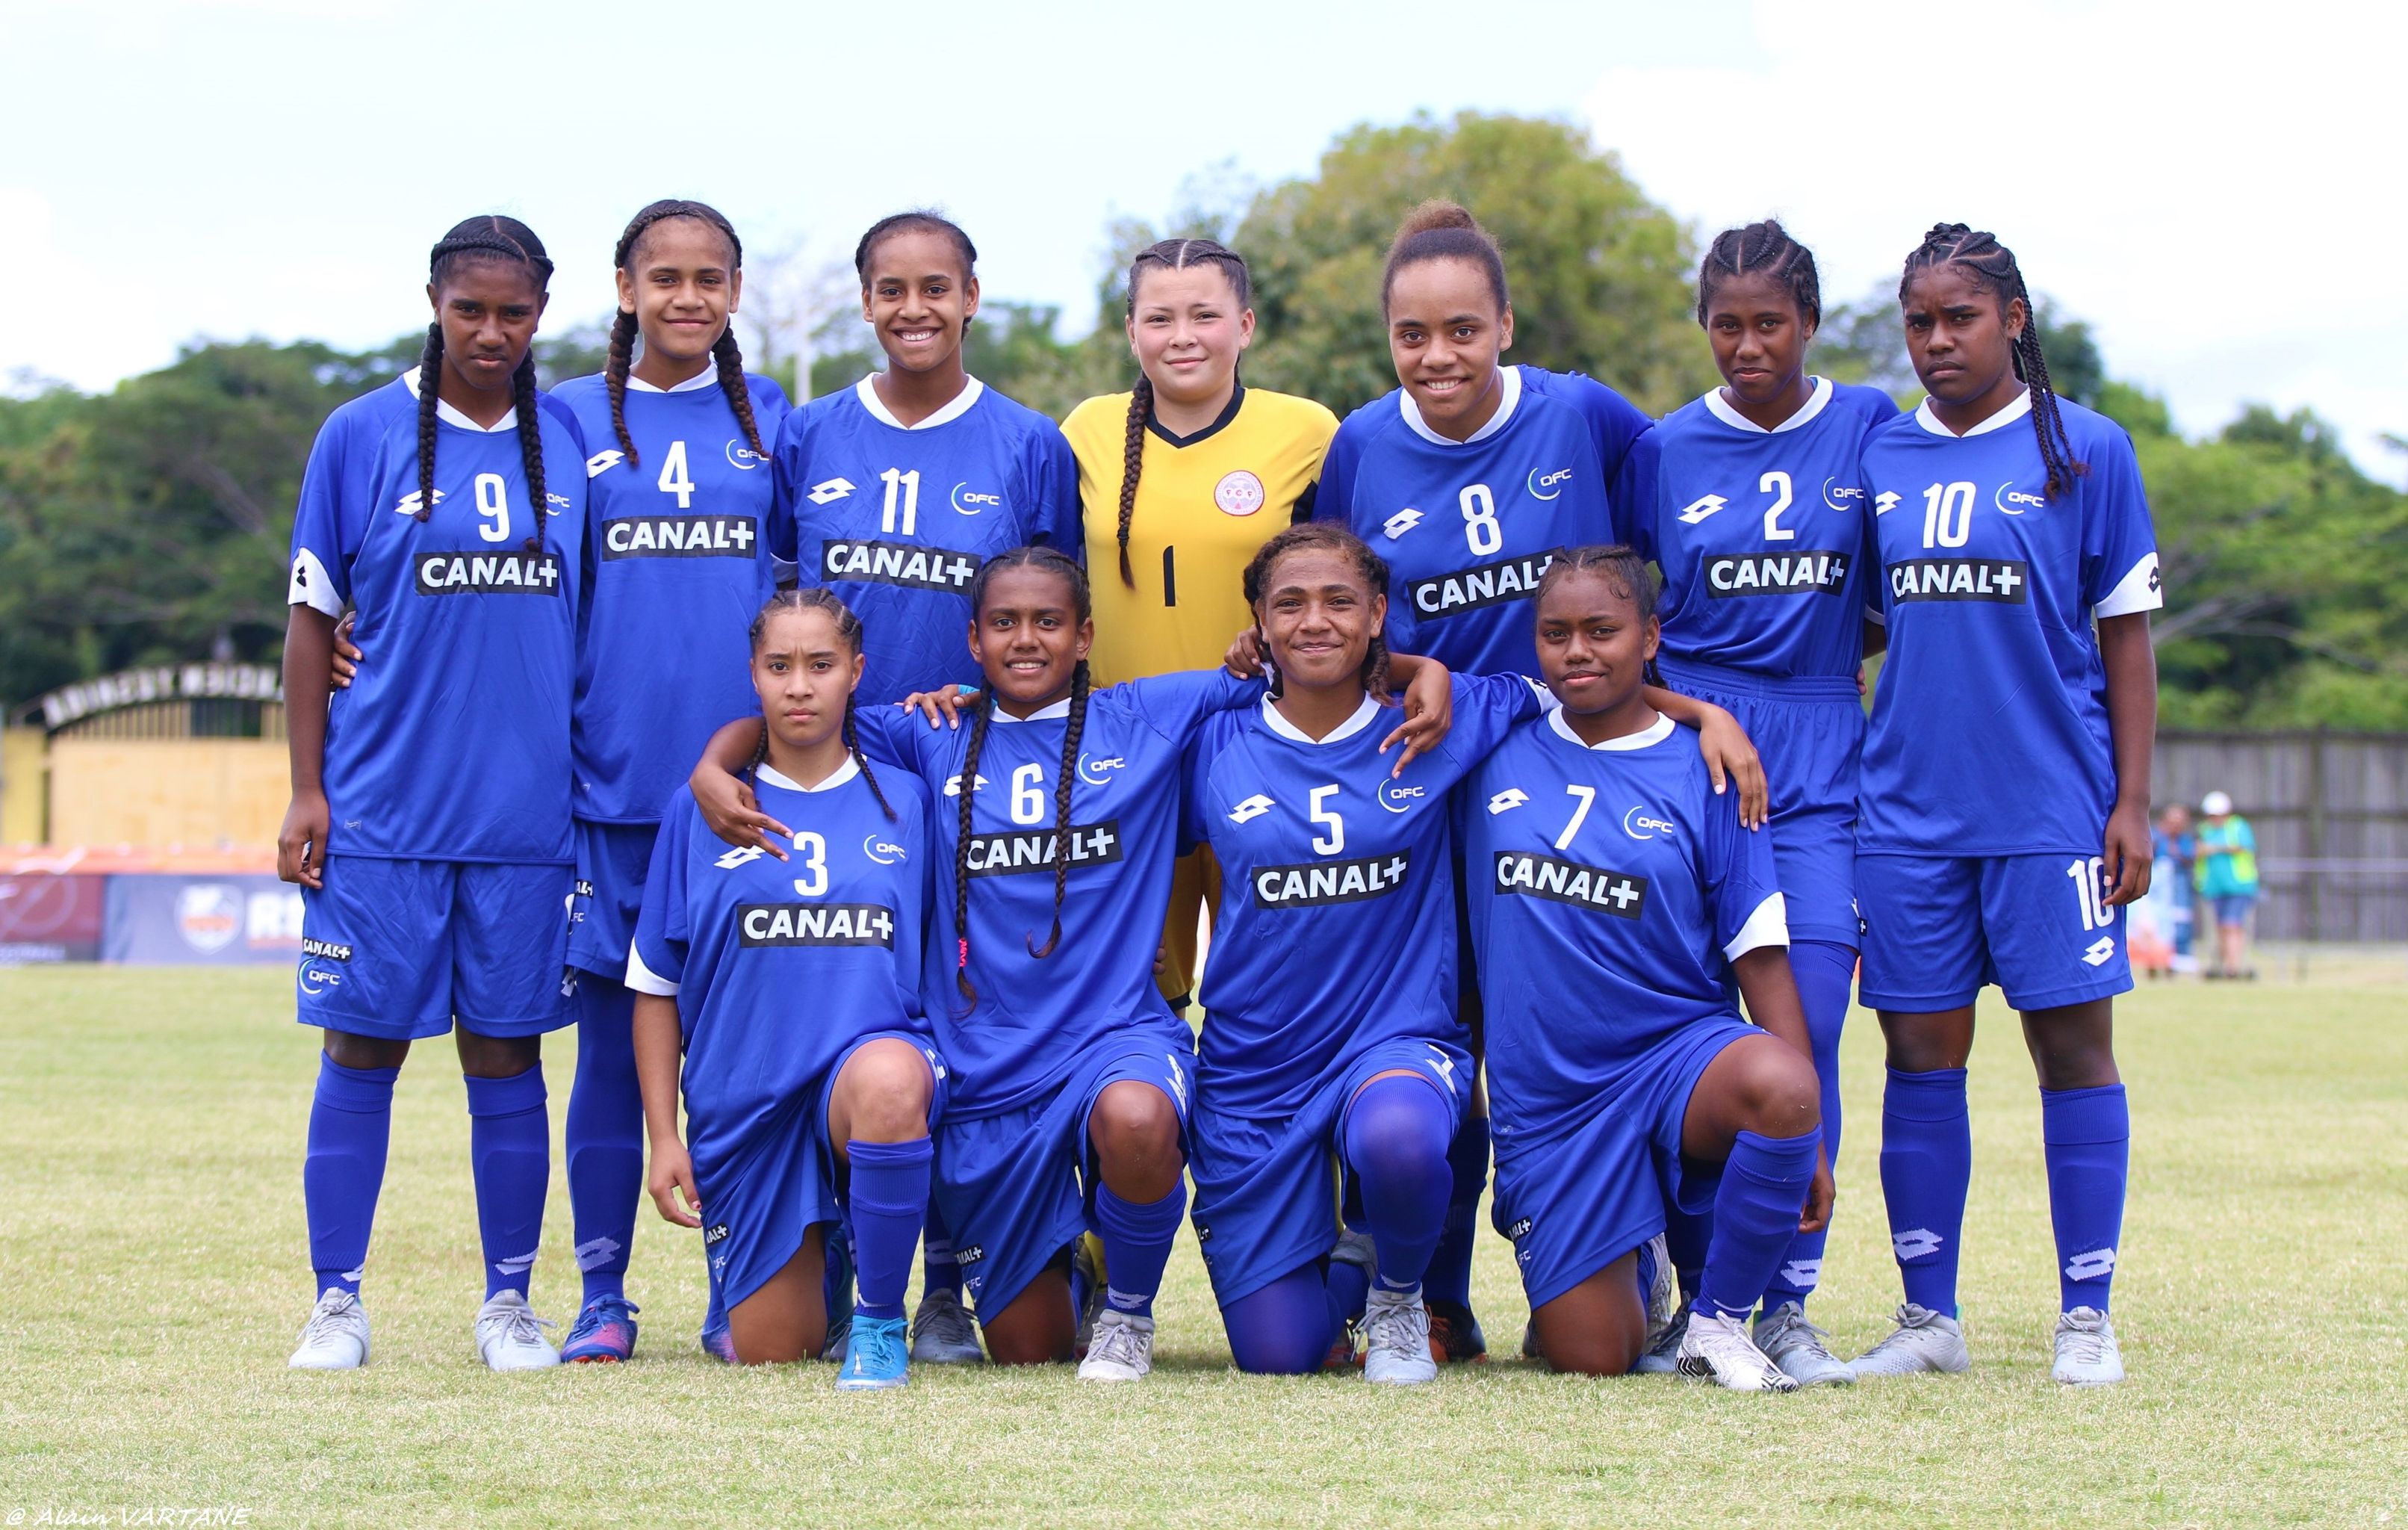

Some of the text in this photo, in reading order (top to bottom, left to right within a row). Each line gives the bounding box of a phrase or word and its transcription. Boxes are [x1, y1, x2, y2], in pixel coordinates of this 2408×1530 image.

[658, 441, 695, 508] 4
[1540, 469, 1571, 486] OFC
[475, 473, 509, 542] 9
[547, 493, 571, 508] OFC
[881, 468, 919, 535] 11
[963, 493, 999, 505] OFC
[1760, 471, 1793, 540] 2
[1834, 488, 1864, 498] OFC
[2008, 492, 2044, 508] OFC
[1459, 484, 1502, 555] 8
[1923, 482, 1976, 548] 10
[608, 521, 754, 551] CANAL+
[422, 557, 556, 587] CANAL+
[828, 545, 973, 586] CANAL+
[1163, 545, 1176, 607] 1
[1711, 557, 1843, 589] CANAL+
[1892, 565, 2020, 597] CANAL+
[1090, 758, 1125, 772] OFC
[1011, 764, 1044, 824] 6
[1391, 787, 1424, 799] OFC
[1310, 784, 1344, 855] 5
[1555, 784, 1595, 850] 7
[1637, 817, 1673, 833] OFC
[793, 831, 828, 896] 3
[876, 843, 905, 859] OFC
[1258, 857, 1406, 901] CANAL+
[1498, 857, 1639, 908] CANAL+
[2067, 857, 2114, 931] 10
[745, 909, 893, 940] CANAL+
[308, 970, 341, 985] OFC
